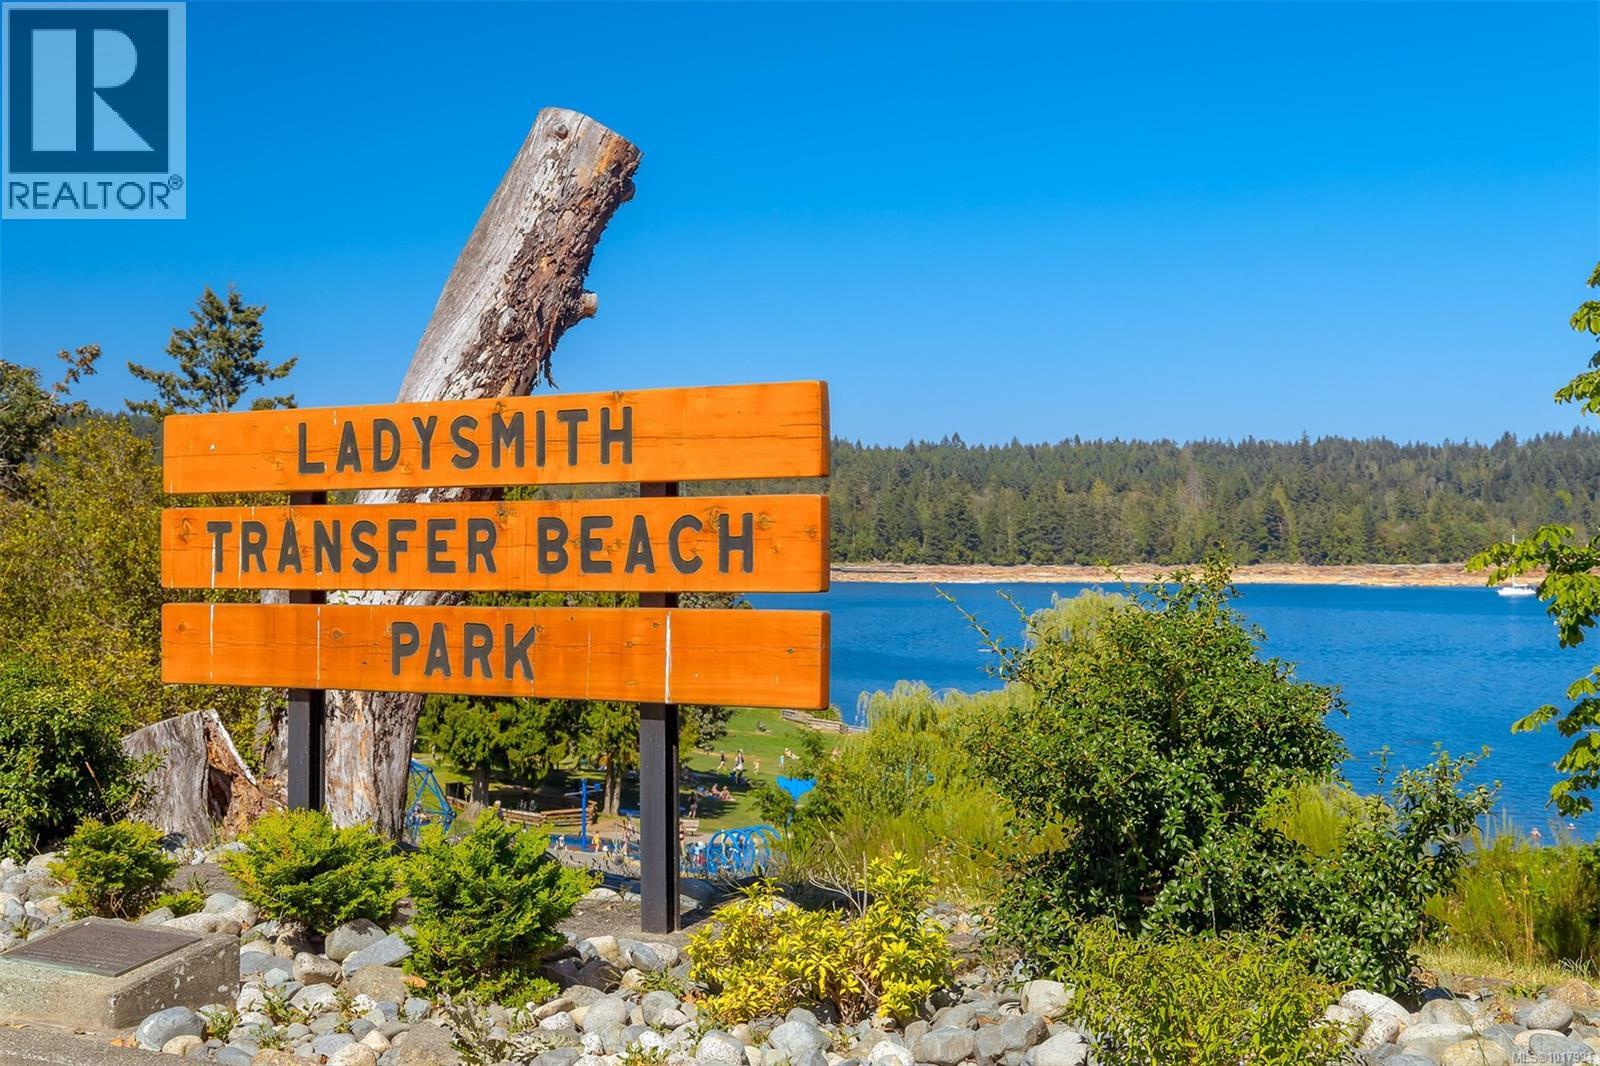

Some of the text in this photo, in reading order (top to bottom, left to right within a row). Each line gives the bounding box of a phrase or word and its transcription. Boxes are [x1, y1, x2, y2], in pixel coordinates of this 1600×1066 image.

[298, 406, 633, 474] LADYSMITH
[206, 512, 755, 574] TRANSFER BEACH
[391, 620, 536, 680] PARK
